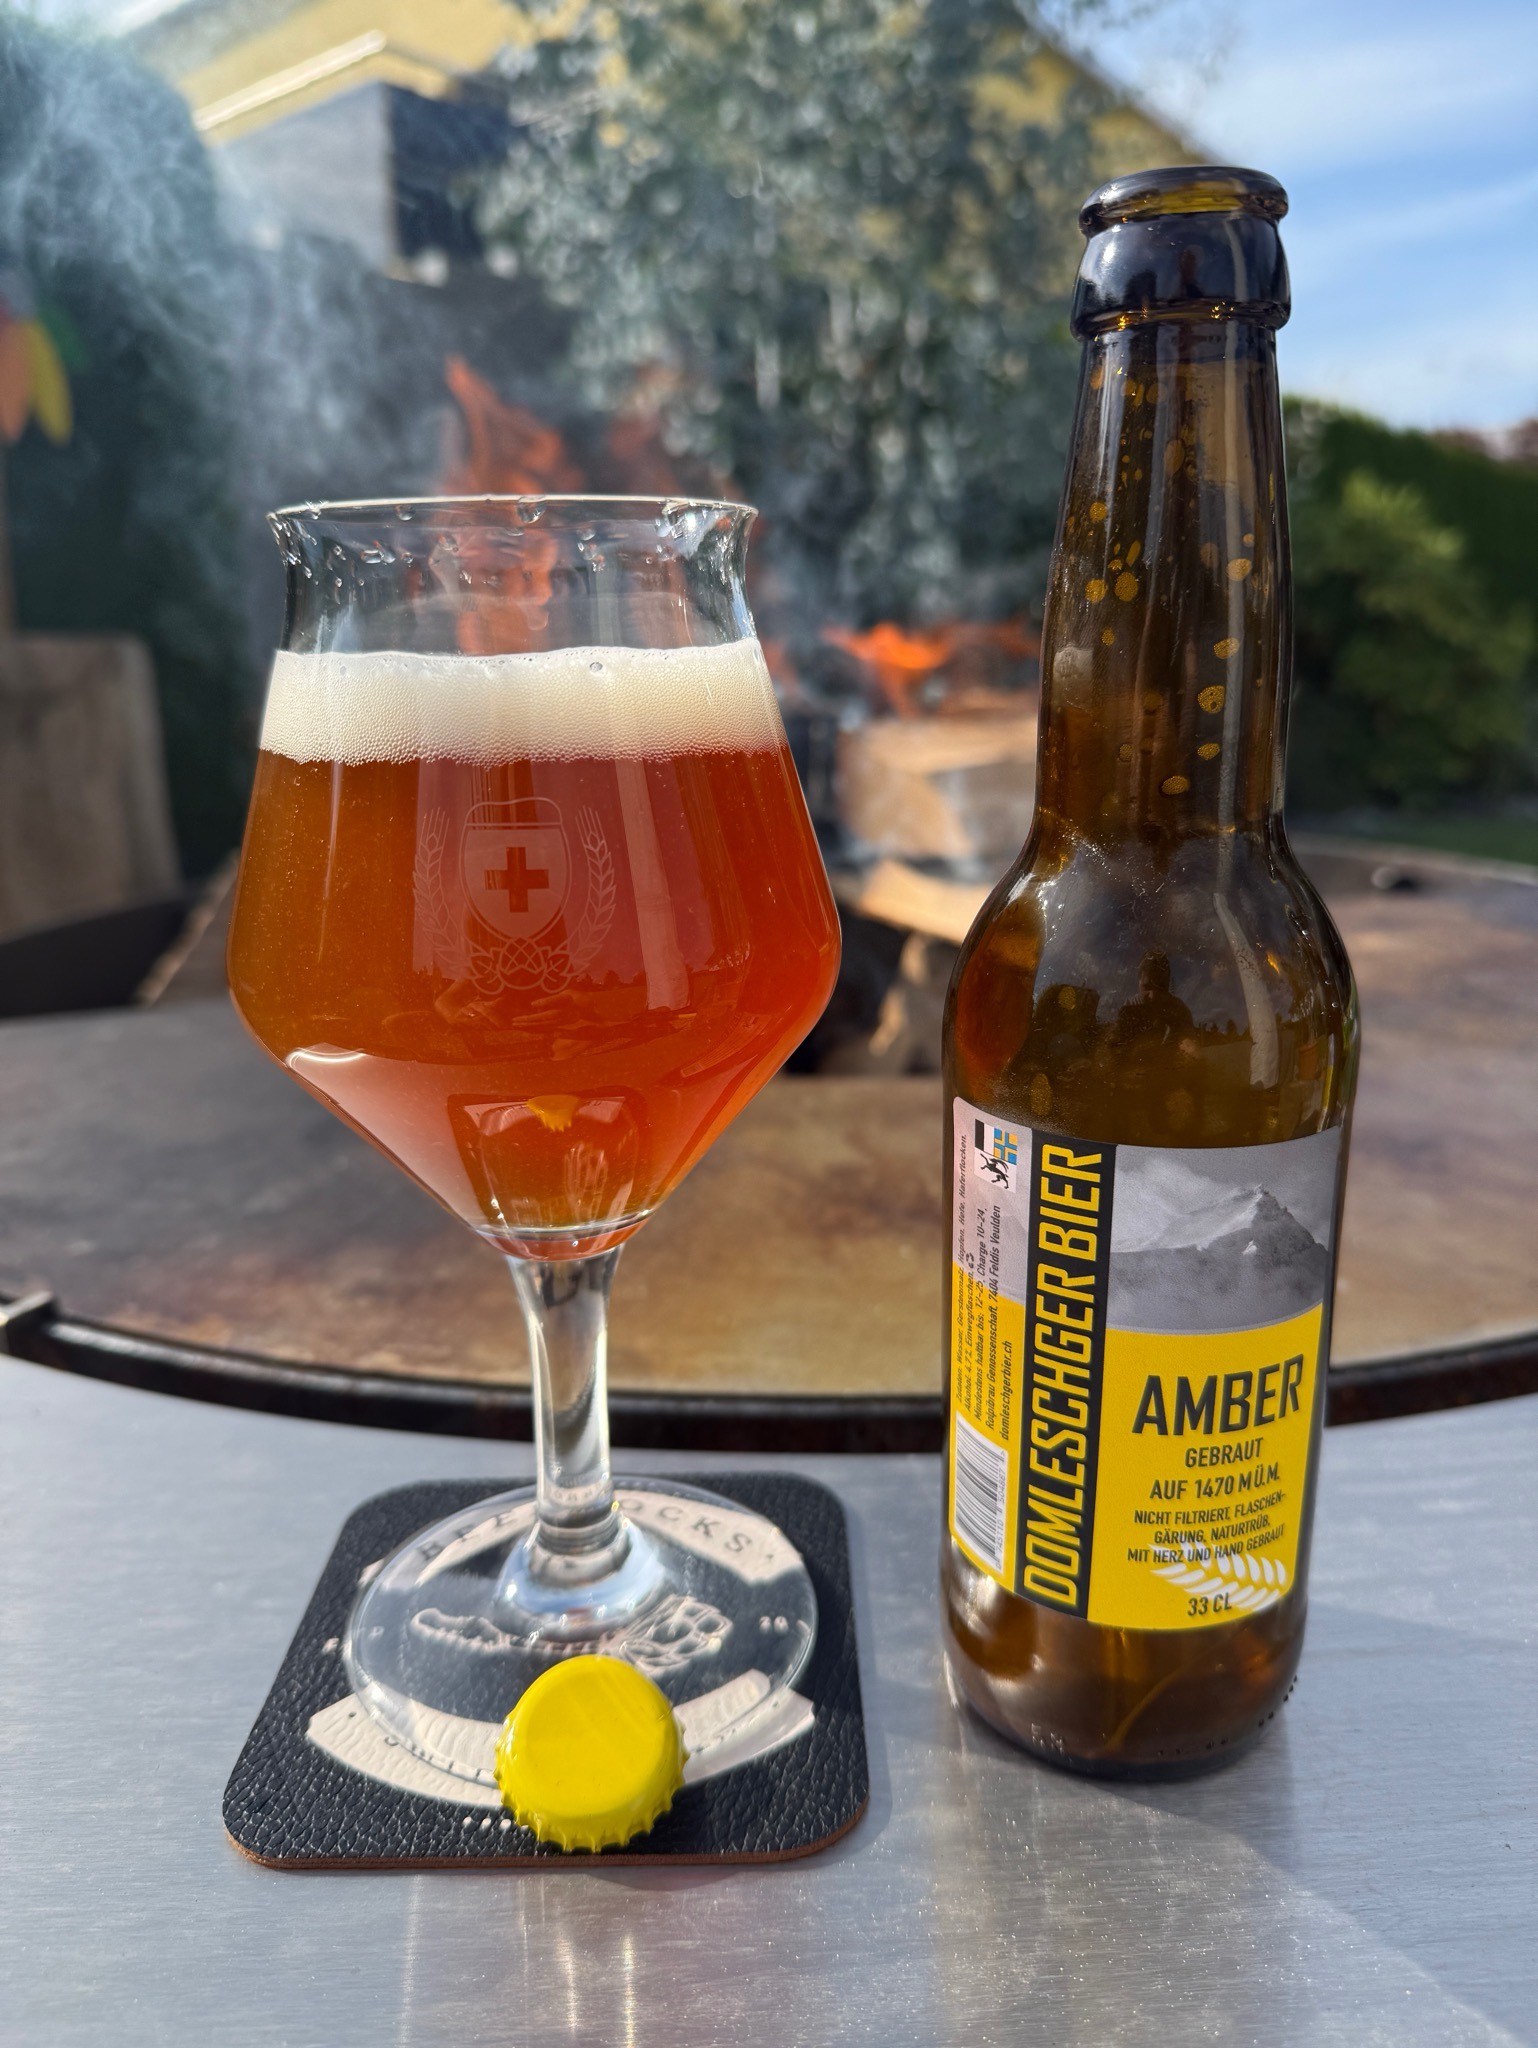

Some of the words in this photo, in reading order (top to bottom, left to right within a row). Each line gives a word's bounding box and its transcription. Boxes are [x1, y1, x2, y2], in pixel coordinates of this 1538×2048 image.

[1038, 1143, 1102, 1262] BIER
[990, 1205, 1001, 1245] Veulden
[976, 1241, 988, 1277] Charge
[989, 1245, 1000, 1278] Feldis
[988, 1278, 999, 1303] 7404
[974, 1330, 984, 1367] haltbar
[973, 1369, 983, 1421] Mindestens
[999, 1340, 1013, 1441] domleschgerbier.ch
[1131, 1353, 1304, 1436] AMBER
[1023, 1262, 1096, 1607] DOMLESCHGER
[1185, 1437, 1264, 1468] GEBRAUT
[1149, 1479, 1188, 1500] AUF
[1194, 1475, 1234, 1499] 1470
[1133, 1510, 1172, 1525] NICHT
[1234, 1489, 1286, 1518] FLASCHEN-
[1127, 1548, 1150, 1563] MIT
[1152, 1548, 1184, 1564] HERZ
[1187, 1547, 1211, 1563] UND
[1214, 1538, 1244, 1559] HAND
[1246, 1523, 1286, 1551] GEBRAUT
[1187, 1595, 1209, 1617] 33
[1212, 1591, 1232, 1613] CL
